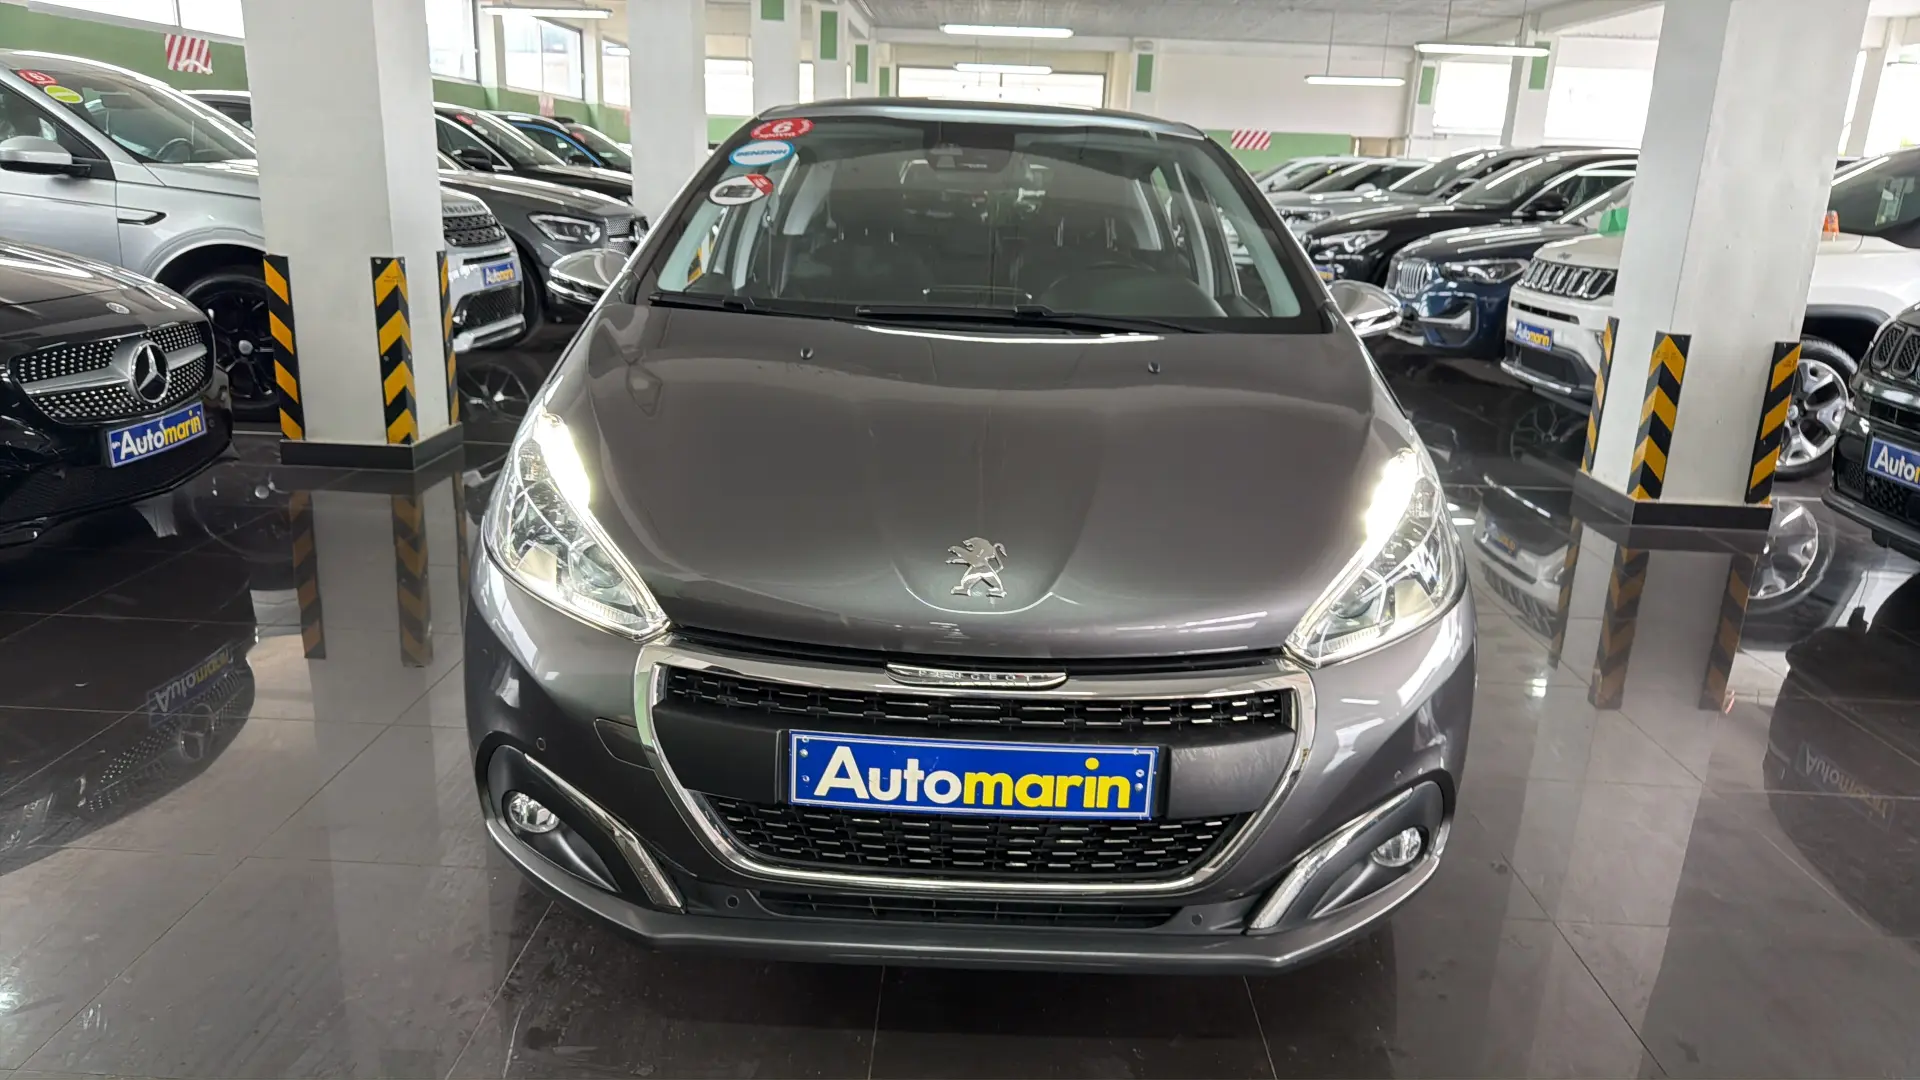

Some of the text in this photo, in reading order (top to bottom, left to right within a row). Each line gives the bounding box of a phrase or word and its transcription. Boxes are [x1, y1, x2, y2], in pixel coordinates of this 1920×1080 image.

[772, 121, 793, 134] 6
[121, 409, 202, 460] Automarin
[918, 669, 1032, 682] PEUGEOT
[813, 745, 1130, 809] Automarin
